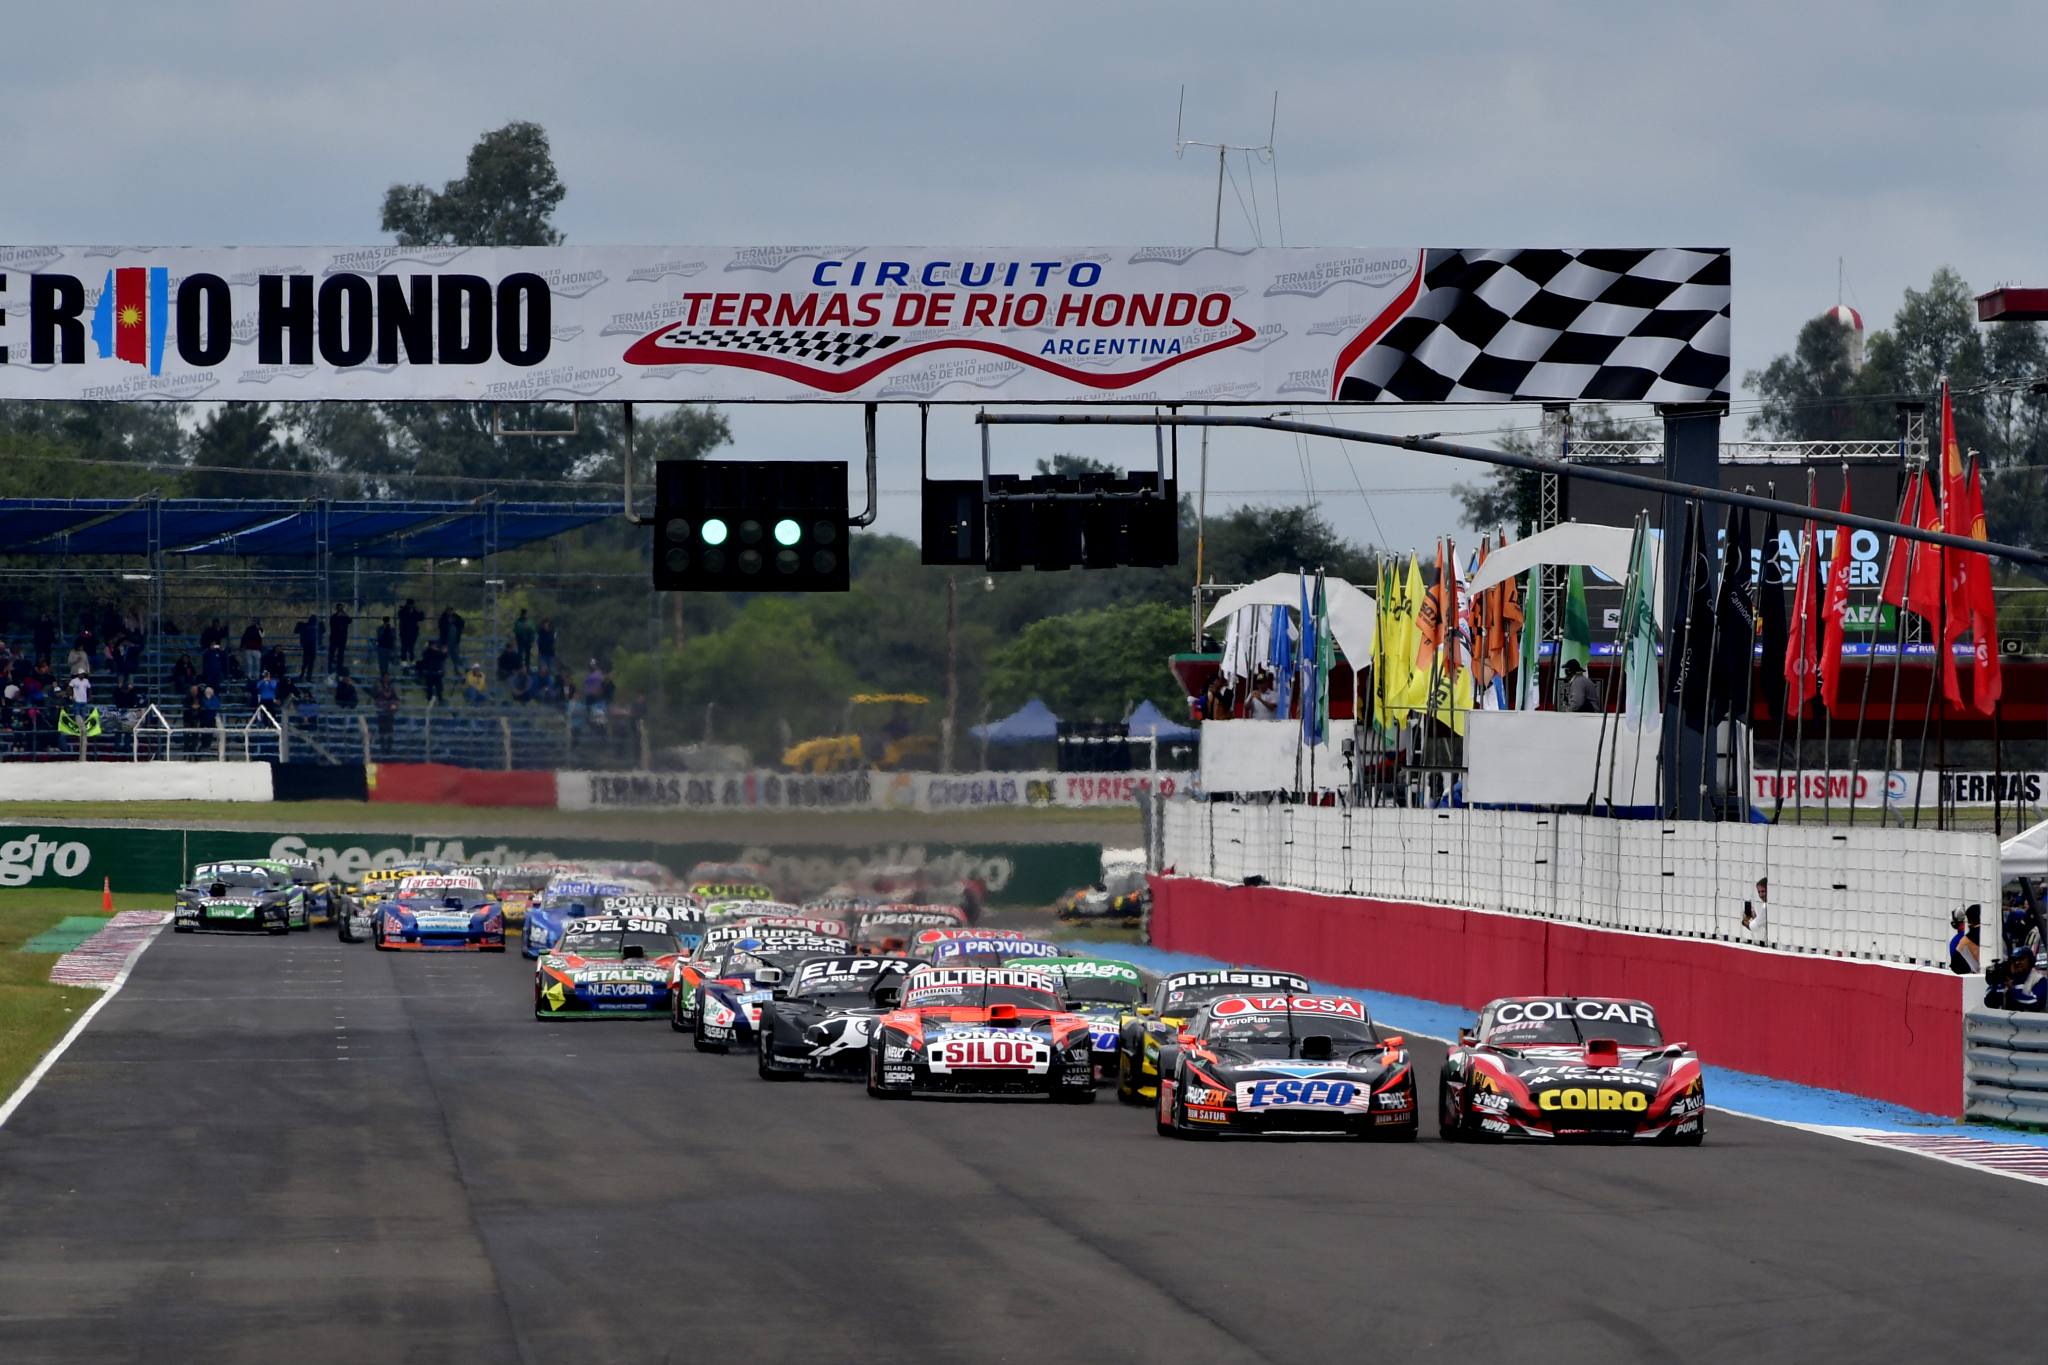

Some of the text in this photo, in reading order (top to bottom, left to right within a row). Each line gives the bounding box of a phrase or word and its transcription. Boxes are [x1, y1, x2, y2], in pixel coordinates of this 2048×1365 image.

[1274, 270, 1323, 285] TERMAS
[1326, 268, 1340, 278] DE
[1365, 259, 1408, 273] HONDO
[1315, 258, 1365, 269] CIRCUITO
[563, 270, 603, 284] HONDO
[812, 260, 1101, 288] CIRCUITO
[612, 311, 660, 324] TERMAS
[683, 293, 884, 326] TERMAS
[892, 293, 956, 326] DE
[1055, 293, 1231, 327] HONDO
[259, 272, 551, 367] HONDO
[1041, 338, 1182, 356] ARGENTINA
[928, 359, 977, 370] CIRCUITO
[486, 382, 535, 395] TERMAS
[537, 378, 551, 389] DE
[575, 367, 616, 381] HONDO
[888, 374, 936, 387] TERMAS
[938, 370, 953, 382] DE
[978, 361, 1019, 375] HONDO
[82, 382, 131, 398] TERMAS
[132, 380, 148, 392] DE
[172, 371, 214, 387] HONDO
[1843, 606, 1886, 623] AFA
[1754, 774, 1868, 800] TURISMO
[195, 864, 268, 878] FISPA
[585, 918, 667, 934] DEL SUR
[766, 936, 848, 947] casa
[766, 943, 847, 955] del audio
[966, 941, 1058, 957] PROVIDUS
[573, 969, 668, 983] METALFOR
[831, 974, 856, 982] RUS
[913, 969, 1054, 993] MULTIBANDAS
[1168, 970, 1308, 991] philagro
[588, 984, 654, 996] NUEVOSUR
[1259, 998, 1359, 1017] TACSA
[1497, 1001, 1656, 1029] COLCAR
[1221, 1015, 1270, 1027] AgroPlan
[1489, 1020, 1545, 1037] LOCTITE
[940, 1030, 1045, 1044] BONANO
[945, 1042, 1034, 1063] SILOC
[1564, 1074, 1657, 1088] Kappa
[1250, 1080, 1356, 1107] ESCO
[1483, 1093, 1510, 1111] RUS
[1538, 1087, 1648, 1112] COIRO
[1480, 1118, 1511, 1133] PUMA
